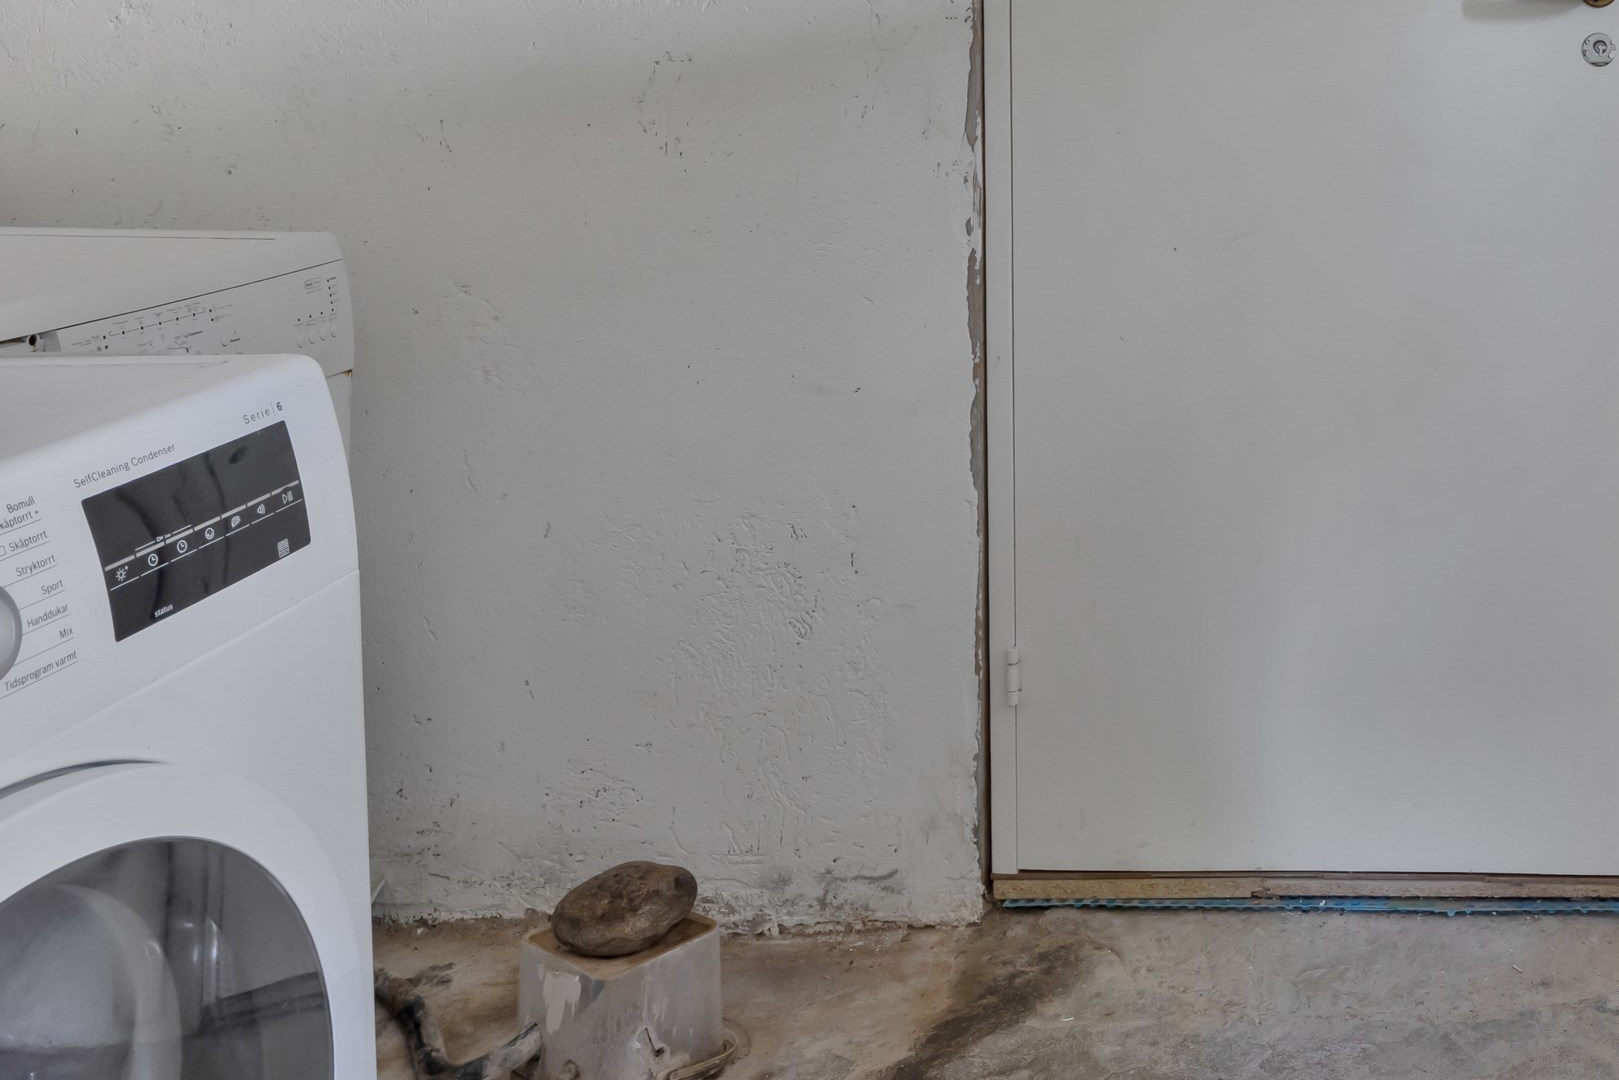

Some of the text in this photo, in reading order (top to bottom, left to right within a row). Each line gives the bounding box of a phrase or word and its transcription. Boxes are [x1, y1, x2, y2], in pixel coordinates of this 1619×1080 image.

[243, 407, 270, 425] Serie
[73, 443, 176, 489] SelfCleaning Condenser
[6, 495, 36, 514] Bomull
[8, 530, 48, 552] Skåptorrt
[16, 554, 56, 577] Stryktorrt
[41, 579, 64, 595] Sport
[27, 604, 69, 628] Handdukar
[154, 603, 174, 618] status
[59, 627, 74, 640] Mix
[4, 650, 77, 691] Tidsprogram varmt
